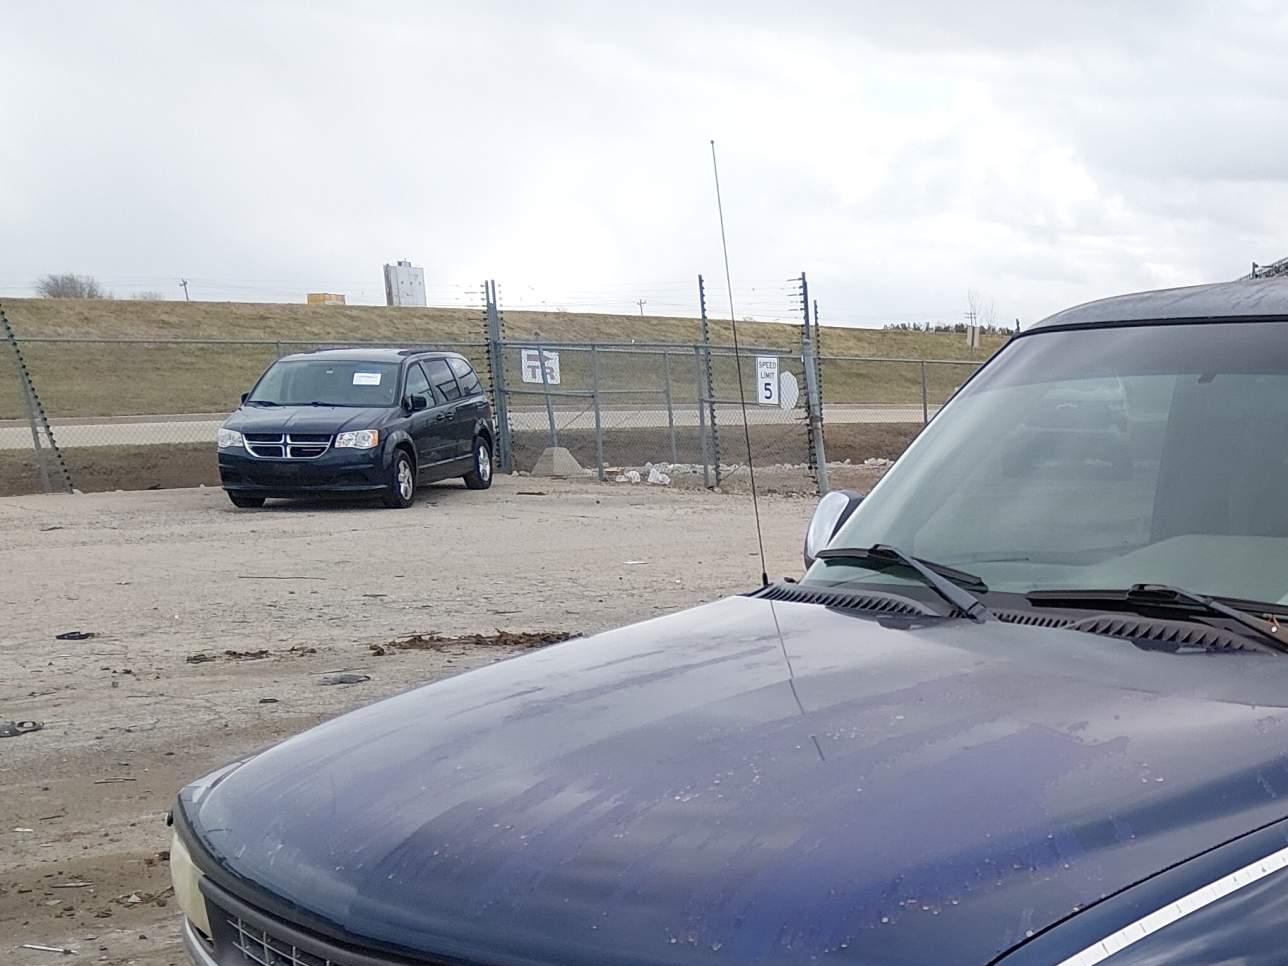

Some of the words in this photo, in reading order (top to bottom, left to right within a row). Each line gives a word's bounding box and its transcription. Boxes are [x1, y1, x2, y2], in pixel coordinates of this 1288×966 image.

[758, 360, 777, 370] SPEED
[760, 370, 776, 380] LIMIT
[763, 382, 773, 400] 5
